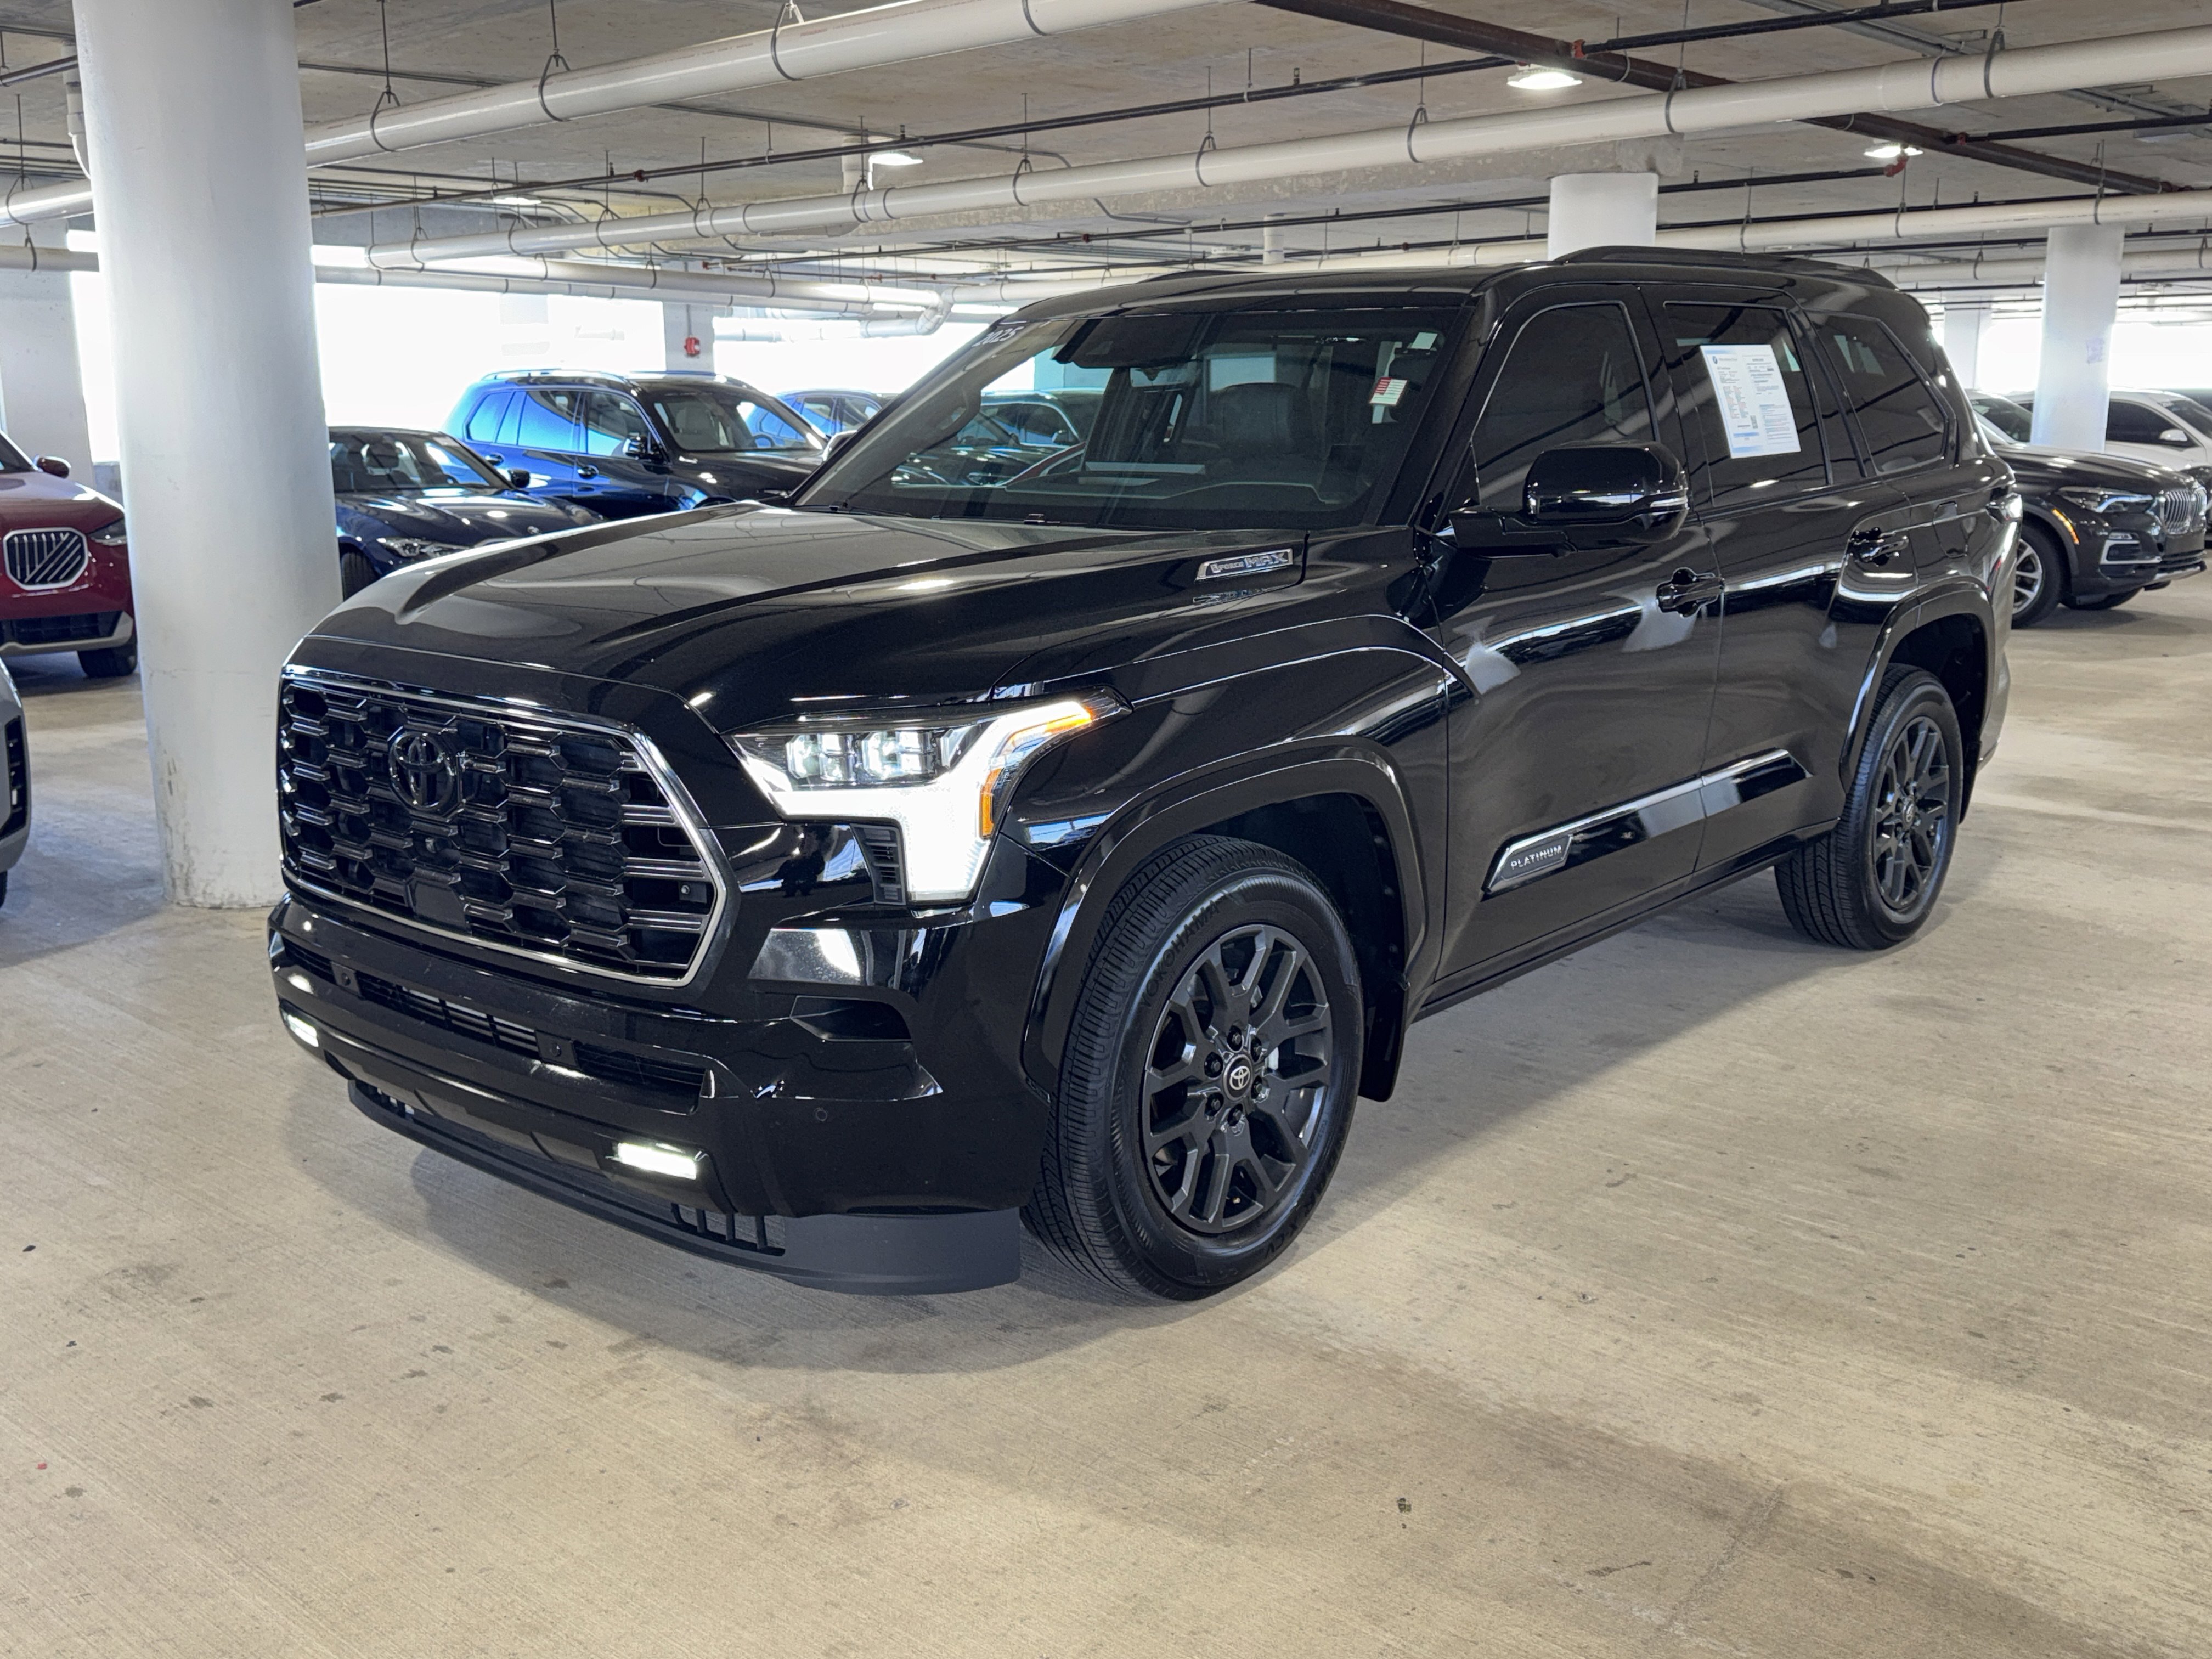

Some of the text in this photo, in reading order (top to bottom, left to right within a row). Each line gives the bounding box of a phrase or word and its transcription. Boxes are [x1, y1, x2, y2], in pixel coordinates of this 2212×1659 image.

[971, 326, 1025, 347] 2025
[1244, 552, 1289, 568] MAX
[1510, 845, 1562, 870] PLATINUM
[1138, 901, 1221, 1010] YOKOHAMA
